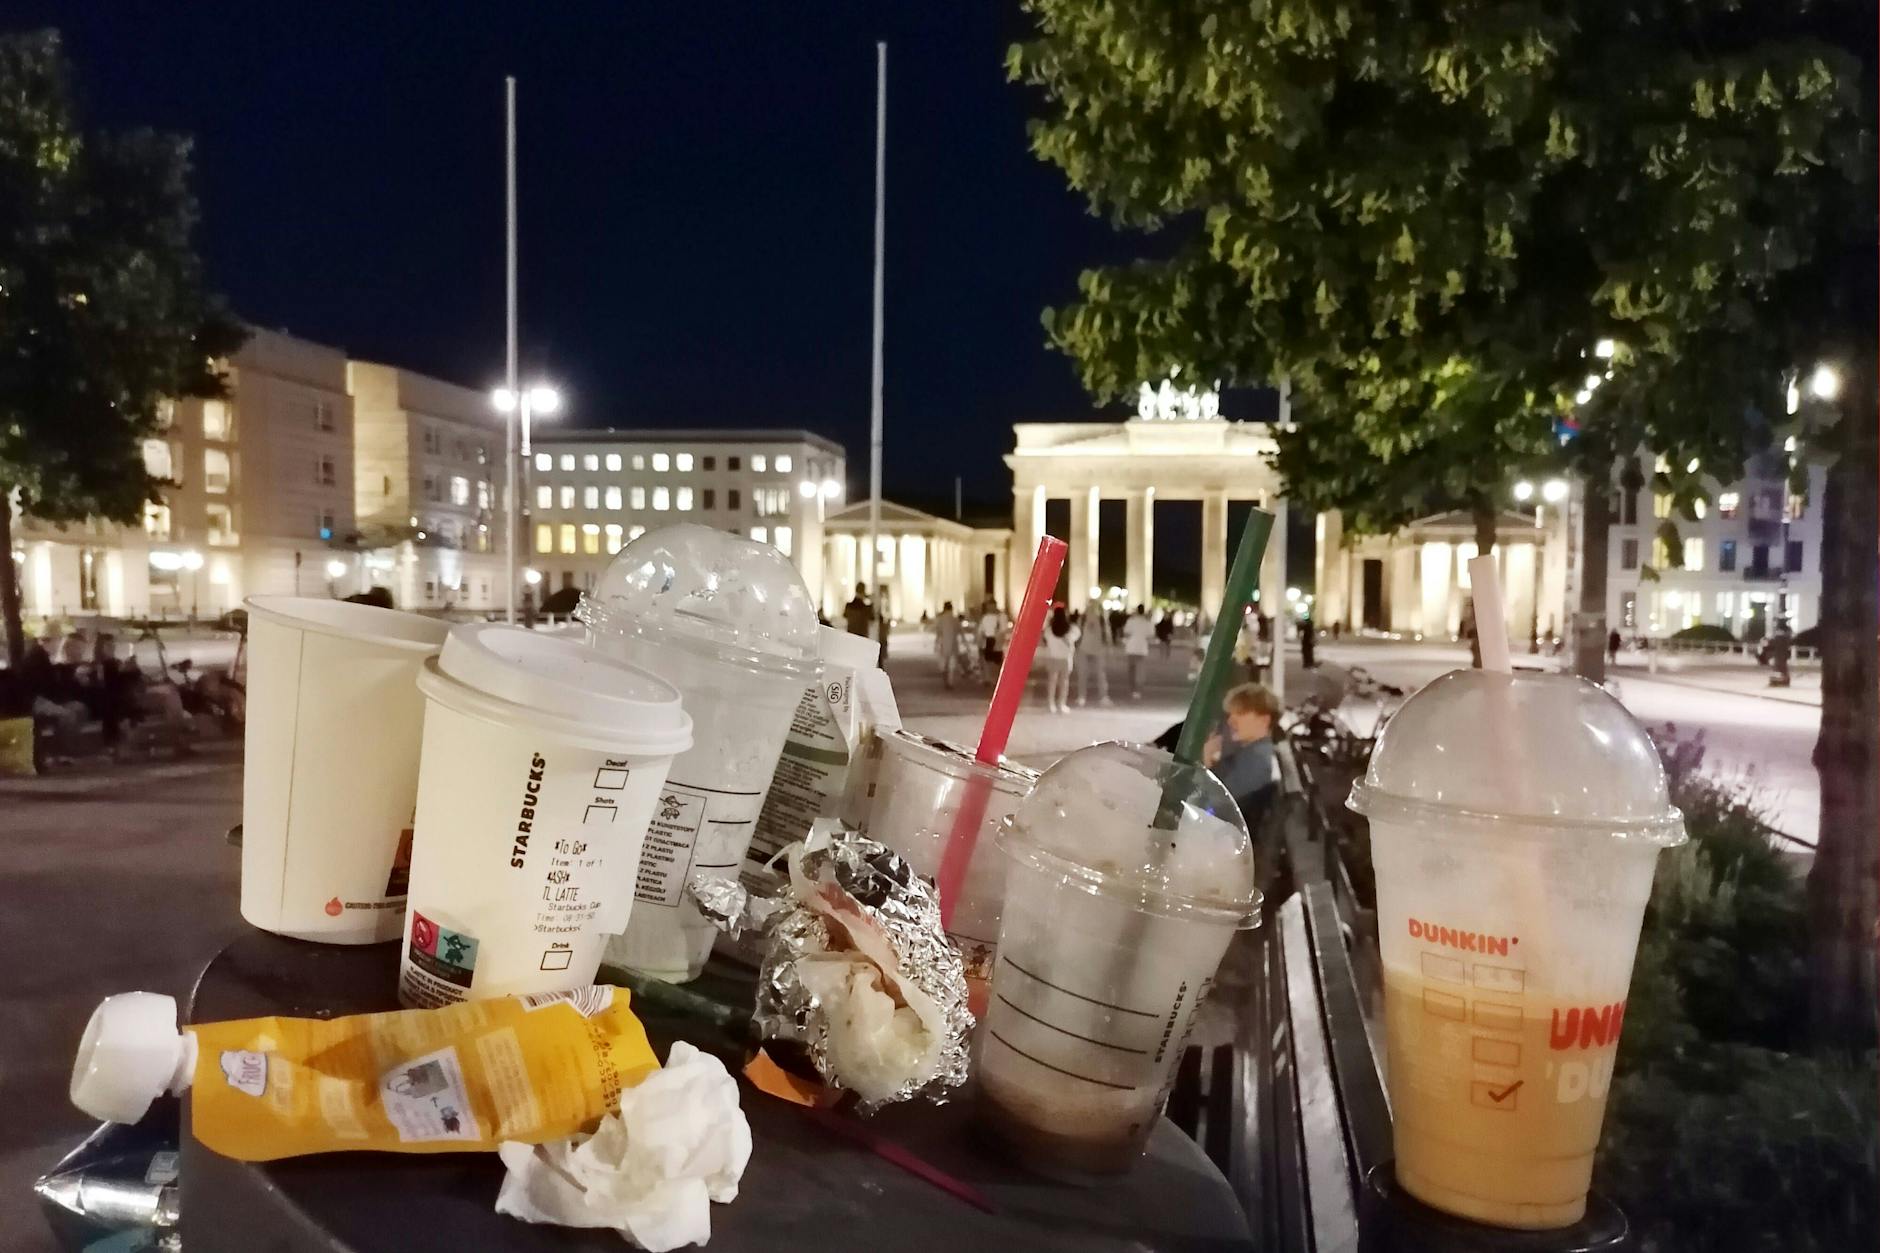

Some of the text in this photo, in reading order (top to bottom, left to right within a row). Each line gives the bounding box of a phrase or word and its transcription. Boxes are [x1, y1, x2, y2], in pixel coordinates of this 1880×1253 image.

[830, 685, 840, 700] SIG
[555, 887, 580, 901] LATTE
[1154, 980, 1188, 1064] STARBUCKS
